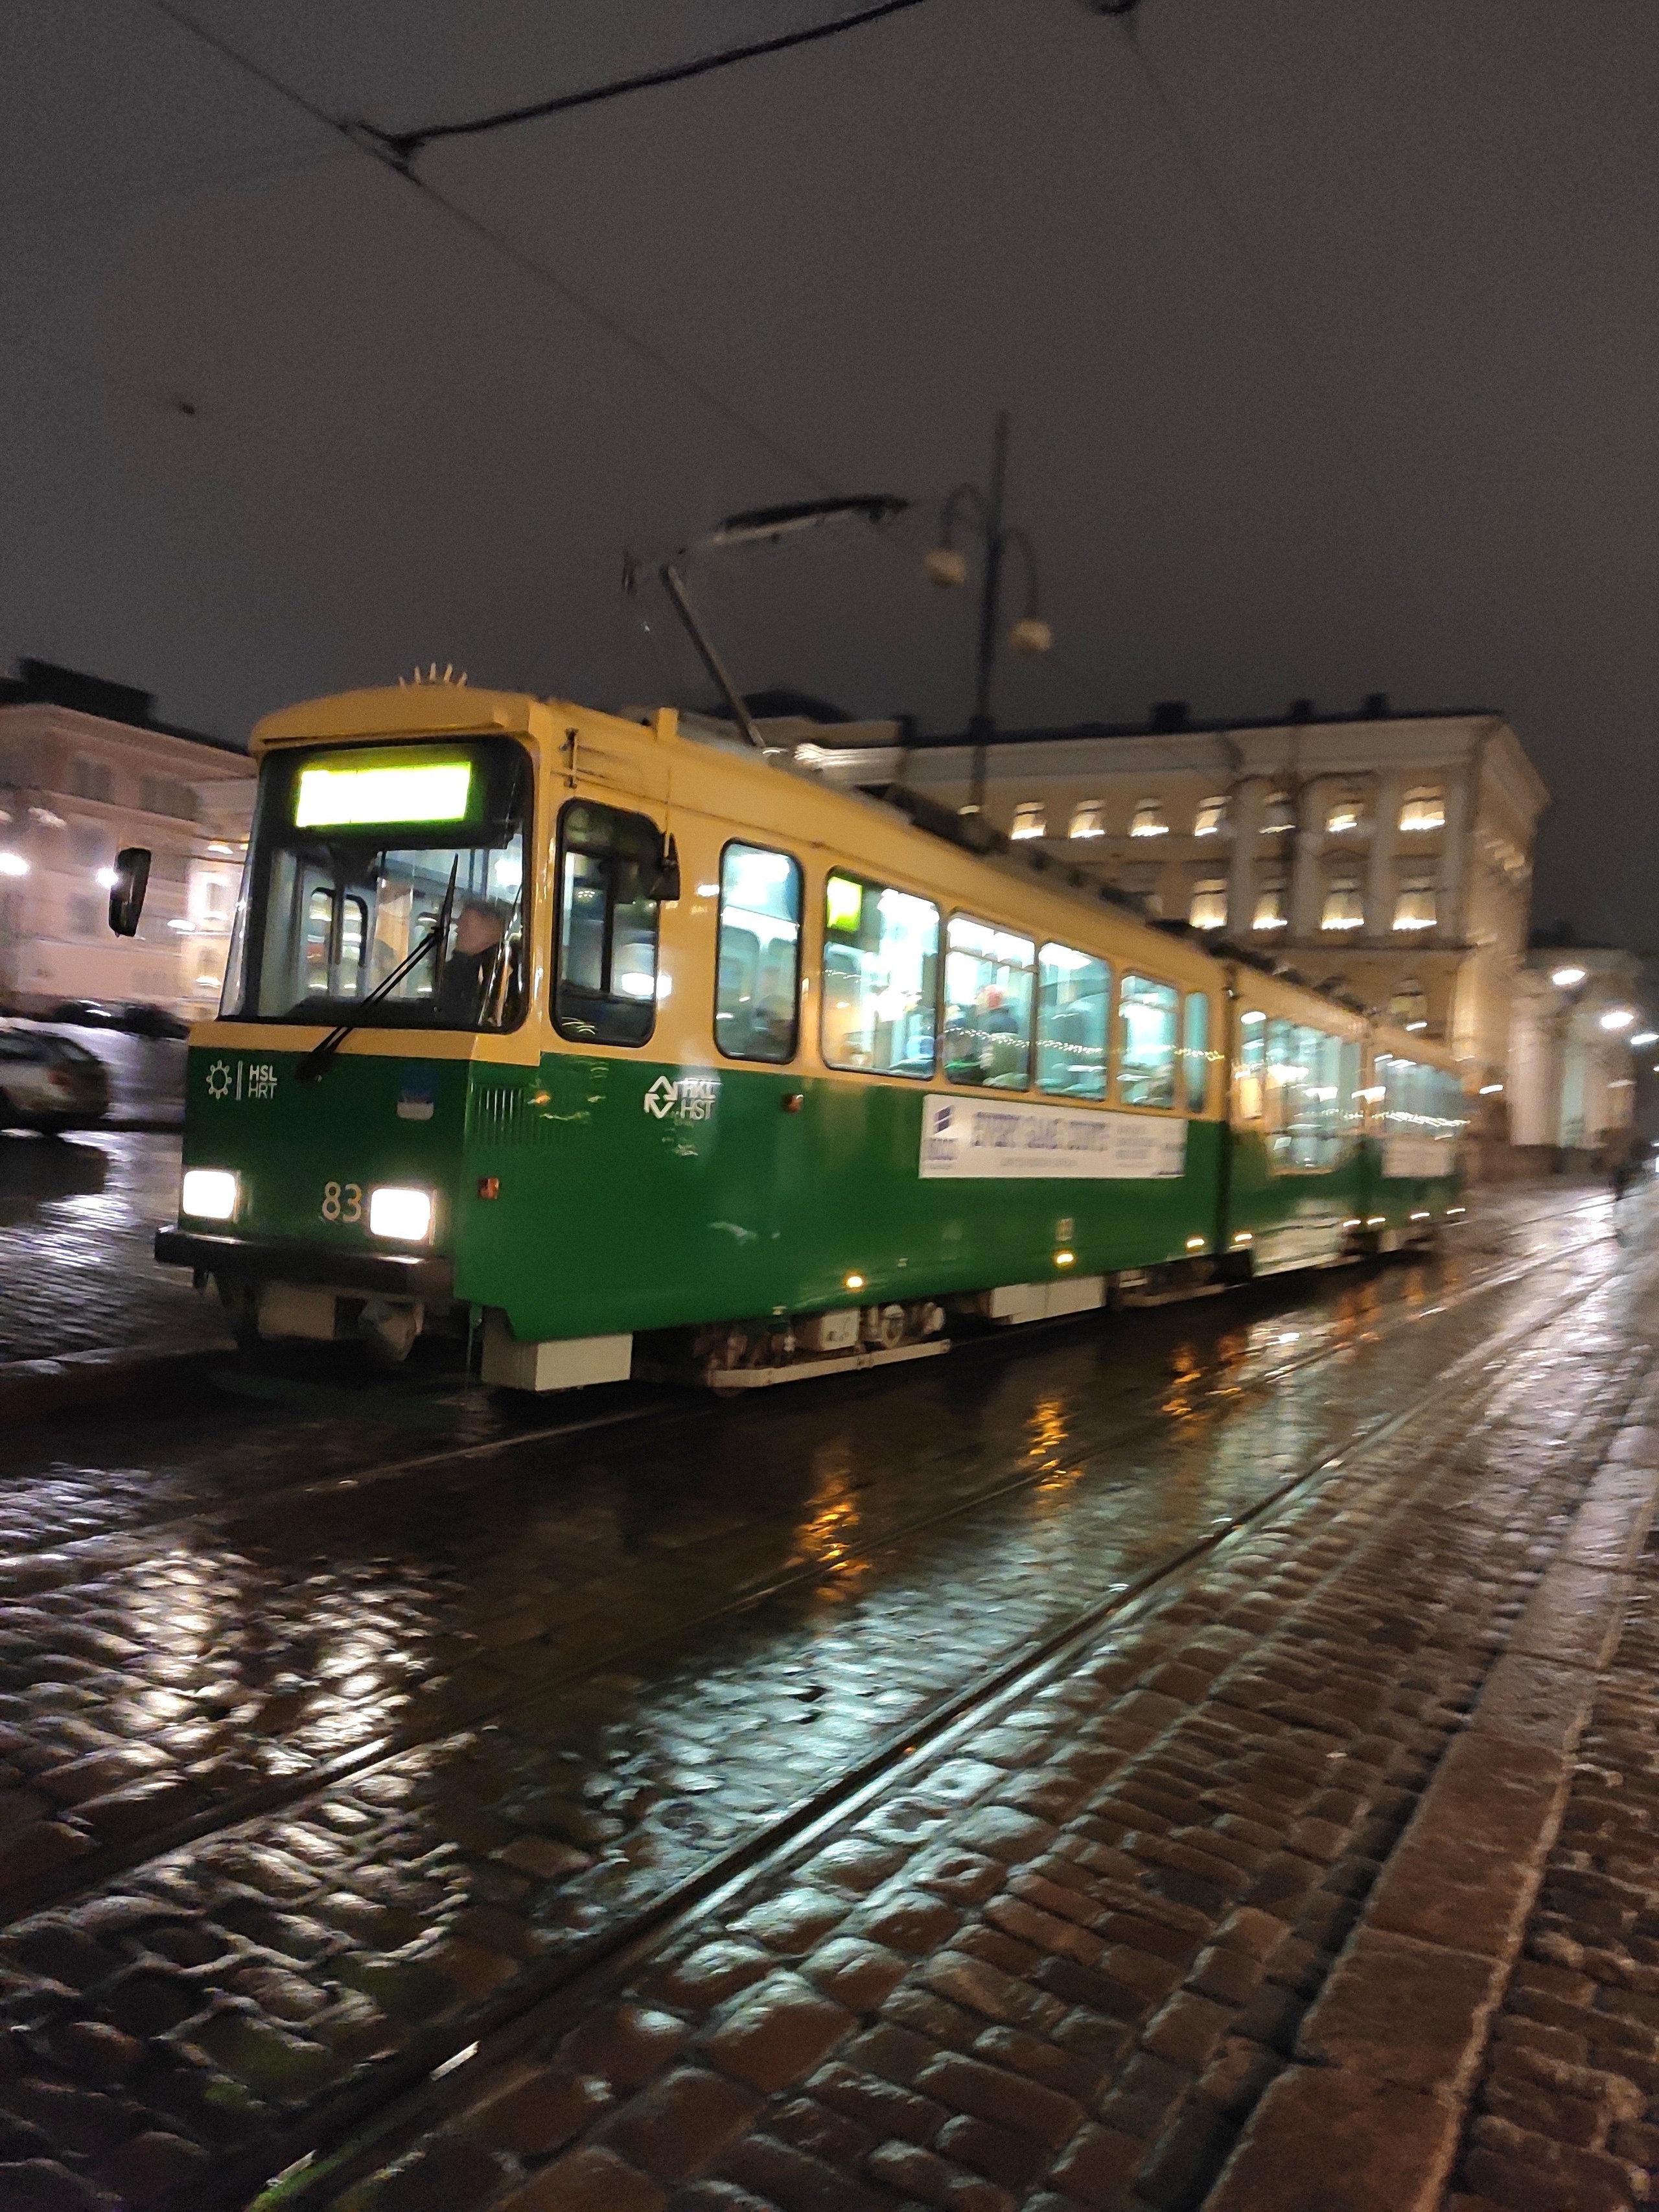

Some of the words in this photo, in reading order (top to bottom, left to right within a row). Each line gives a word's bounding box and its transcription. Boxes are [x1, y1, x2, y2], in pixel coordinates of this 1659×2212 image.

[249, 1064, 277, 1082] HSL
[248, 1082, 278, 1099] HRT
[680, 1099, 715, 1121] HST
[321, 1181, 362, 1223] 83
